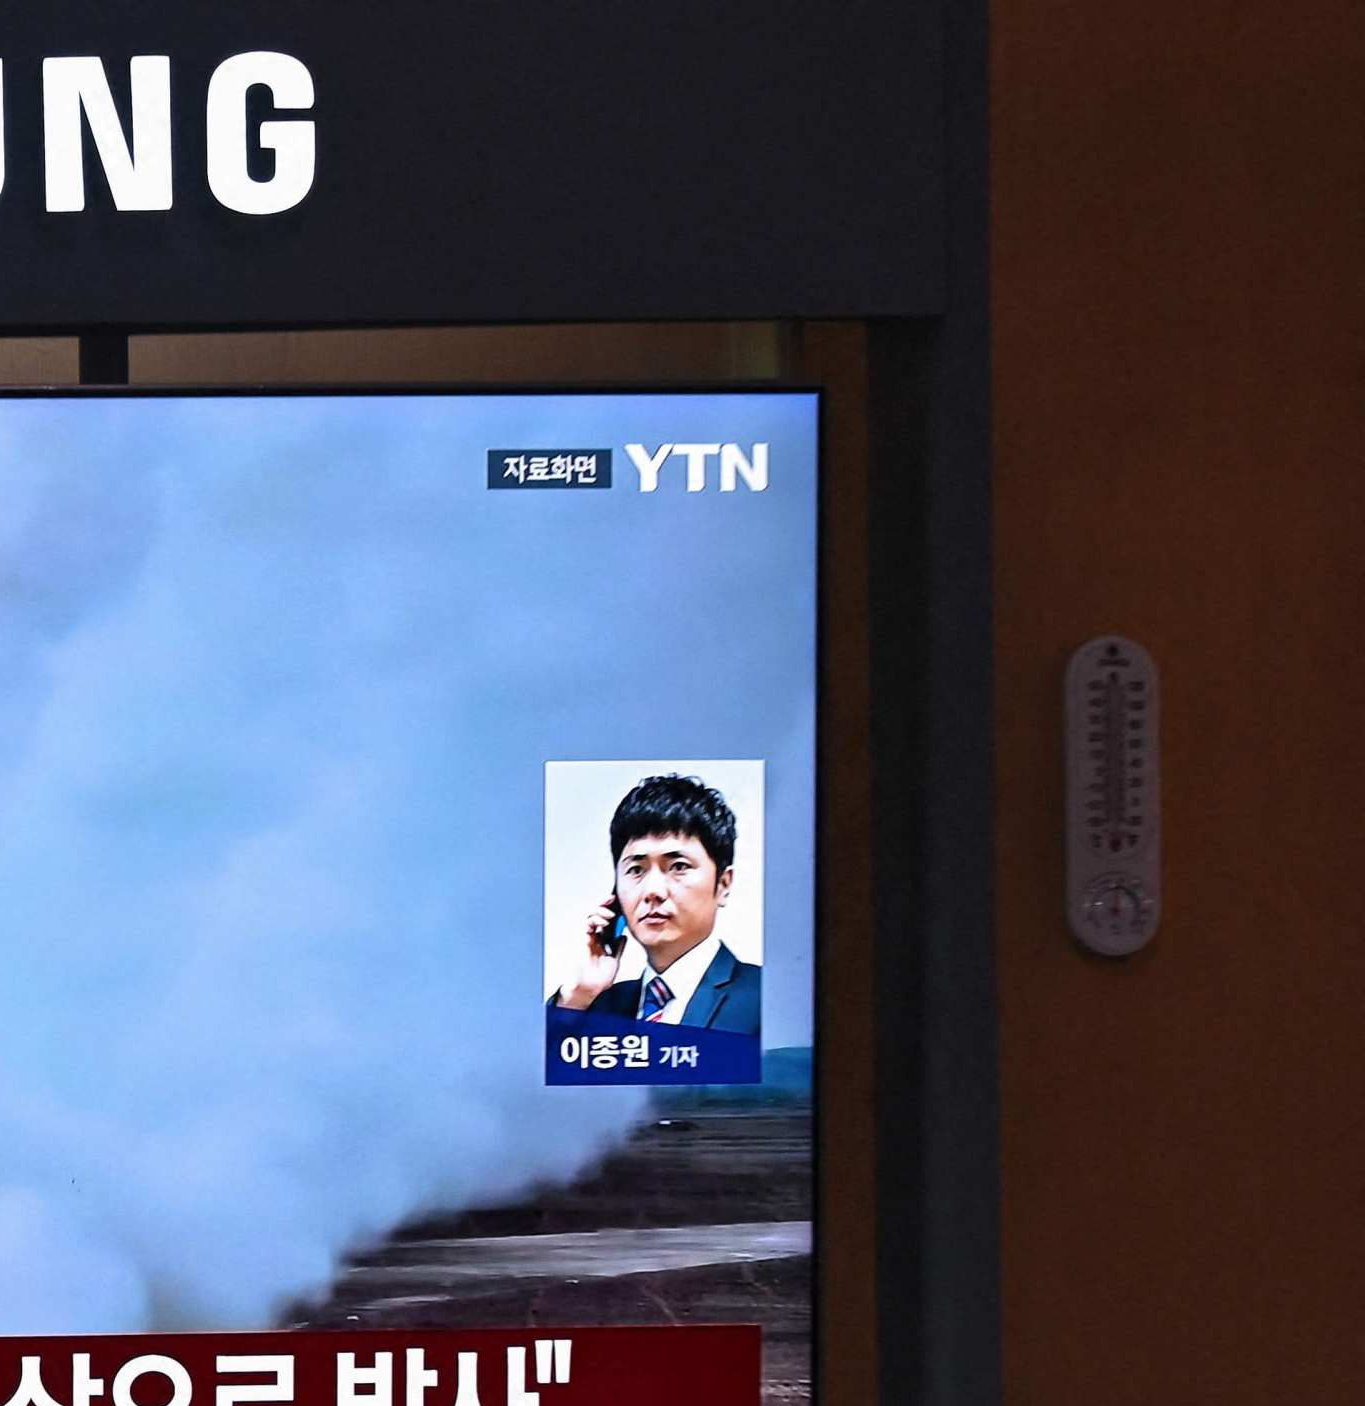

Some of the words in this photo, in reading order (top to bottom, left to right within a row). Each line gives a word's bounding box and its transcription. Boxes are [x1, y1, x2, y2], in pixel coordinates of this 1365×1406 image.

[503, 454, 597, 484] 자료화면
[626, 443, 767, 492] YTN
[560, 1035, 649, 1069] 이종원
[659, 1045, 700, 1068] 기자
